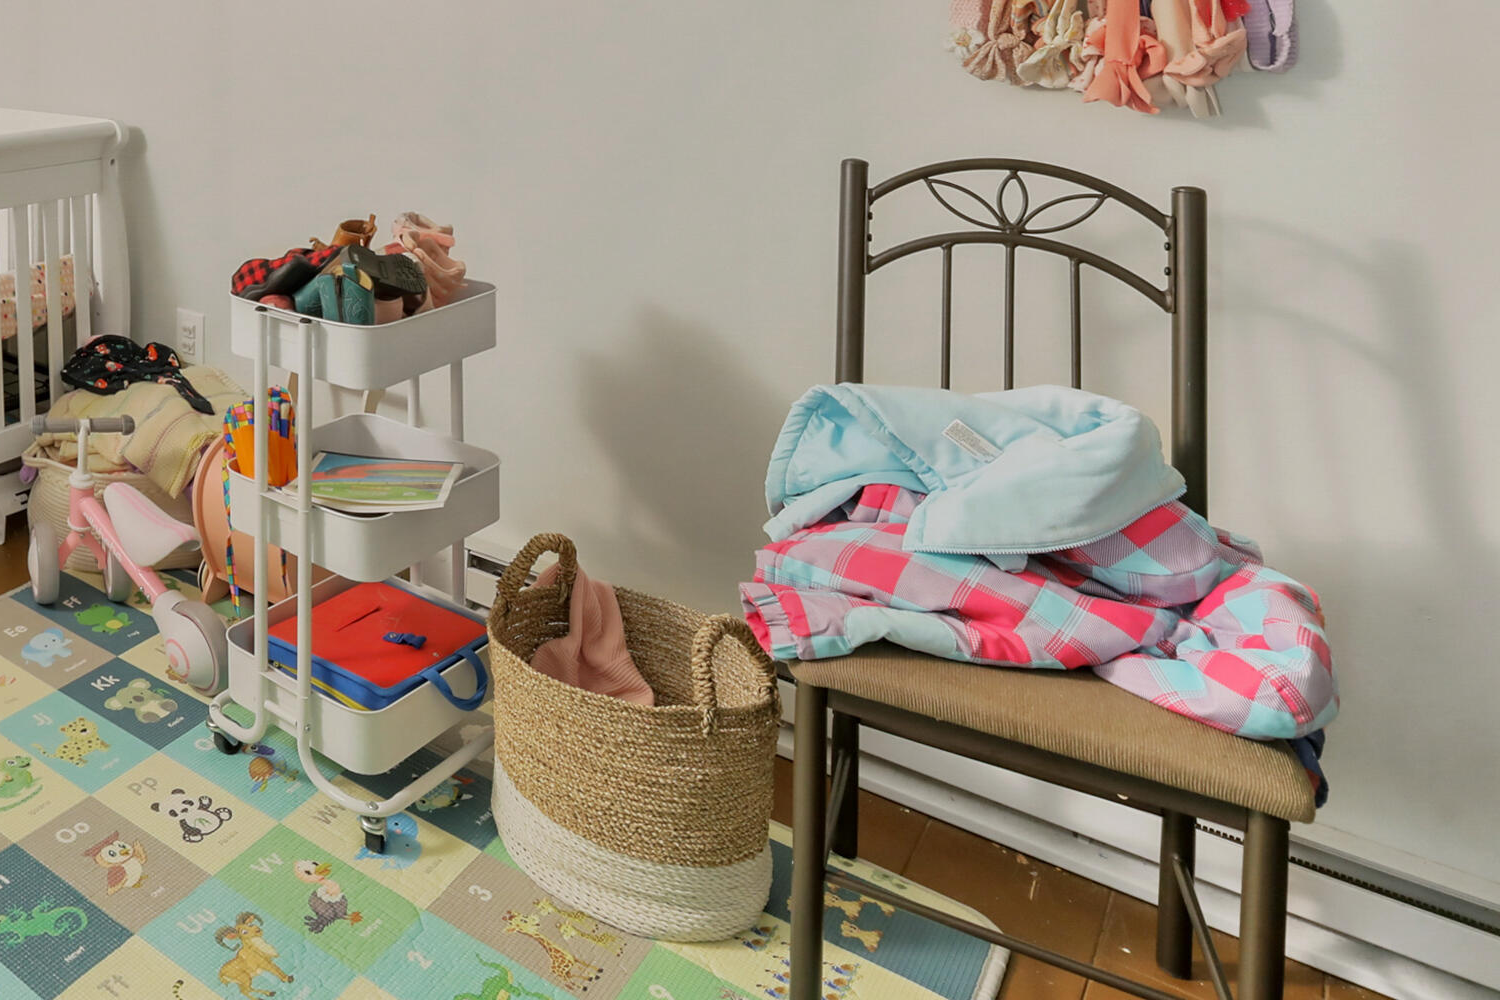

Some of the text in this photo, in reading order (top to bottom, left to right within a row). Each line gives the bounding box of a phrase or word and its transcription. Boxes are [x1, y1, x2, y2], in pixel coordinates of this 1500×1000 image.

[4, 625, 28, 638] Ee
[91, 675, 120, 691] Kk
[56, 822, 90, 843] Oo
[468, 884, 493, 902] 3
